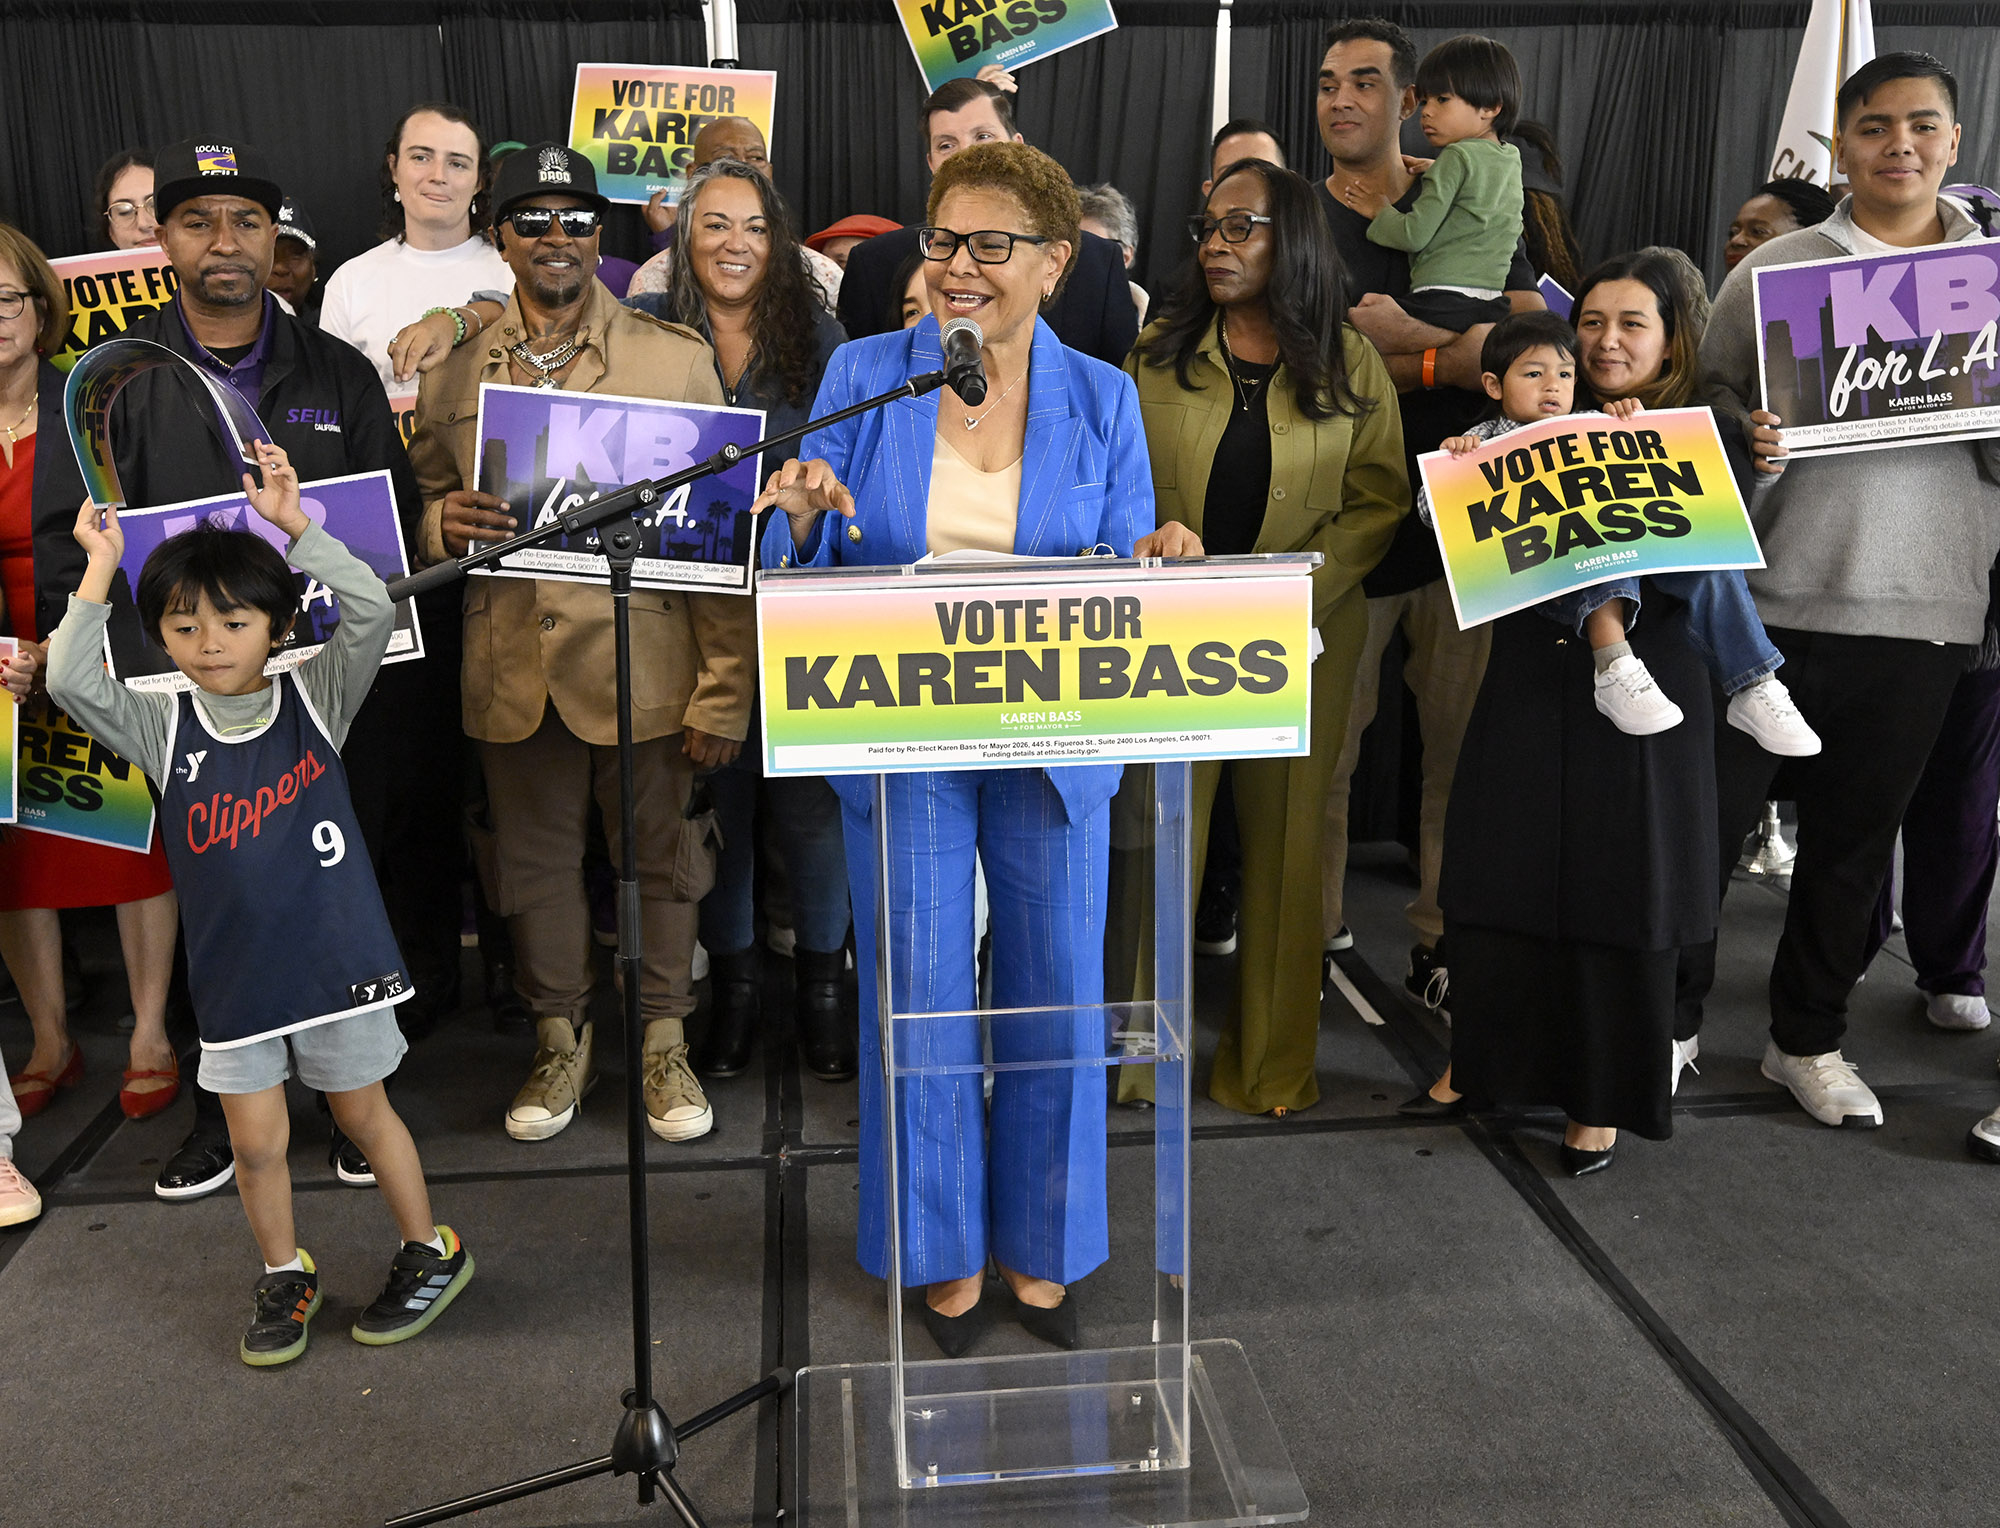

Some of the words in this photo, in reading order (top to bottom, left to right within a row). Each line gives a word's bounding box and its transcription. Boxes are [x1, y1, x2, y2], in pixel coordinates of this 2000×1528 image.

[947, 0, 1067, 63] BASS
[613, 80, 678, 109] VOTE
[684, 84, 735, 113] FOR
[195, 145, 220, 153] LOCAL
[221, 146, 233, 154] 721
[607, 143, 696, 179] BAS
[1829, 254, 2000, 348] KB
[1829, 343, 1912, 418] for
[1889, 396, 1925, 408] KAREN
[1927, 392, 1953, 403] BASS
[286, 408, 340, 425] SEIU
[1803, 428, 1813, 436] for
[1813, 428, 1822, 437] by
[1823, 423, 1854, 434] Re-Elect
[1855, 421, 1877, 431] Karen
[1878, 419, 1897, 428] Bass
[1898, 418, 1908, 426] for
[1909, 415, 1931, 426] Mayor
[1954, 411, 1969, 419] 445
[1824, 434, 1837, 442] Los
[1870, 429, 1882, 437] CA
[1909, 422, 1939, 434] Funding
[1940, 420, 1962, 430] details
[1963, 419, 1971, 428] at
[546, 403, 700, 485] KB
[1479, 432, 1585, 492] VOTE
[1587, 430, 1668, 461] FOR
[1467, 461, 1704, 543] KAREN
[1502, 500, 1692, 575] BASS
[523, 559, 535, 567] Los
[524, 550, 553, 560] Re-Elect
[553, 552, 574, 562] Karen
[574, 554, 591, 563] Bass
[592, 555, 601, 563] for
[641, 560, 655, 568] 445
[663, 562, 692, 572] Figueroa
[704, 565, 720, 573] Suite
[720, 566, 737, 574] 2400
[1574, 554, 1610, 571] KAREN
[1612, 549, 1639, 561] BASS
[935, 599, 1048, 645] VOTE
[1059, 596, 1142, 641] FOR
[299, 649, 314, 659] 445
[152, 677, 162, 685] for
[163, 675, 171, 683] by
[785, 648, 1060, 710] KAREN
[1079, 639, 1288, 700] BASS
[1001, 712, 1046, 724] KAREN
[1049, 710, 1082, 723] BASS
[18, 726, 131, 782] REN
[896, 746, 905, 755] by
[906, 744, 936, 753] Re-Elect
[938, 744, 958, 752] Karen
[960, 743, 977, 751] Bass
[990, 742, 1011, 752] Mayor
[1013, 742, 1031, 750] 2026,
[1054, 739, 1084, 749] Figueroa
[1098, 738, 1116, 746] Suite
[1117, 737, 1133, 745] 2400
[1149, 735, 1178, 746] Angeles,
[1191, 734, 1212, 742] 90071.
[983, 750, 1011, 759] Funding
[1012, 749, 1035, 758] details
[176, 766, 188, 774] the
[20, 766, 104, 812] SS
[24, 807, 47, 818] BASS
[188, 749, 326, 854] Clippers
[312, 820, 346, 868] 9
[387, 982, 403, 997] XS
